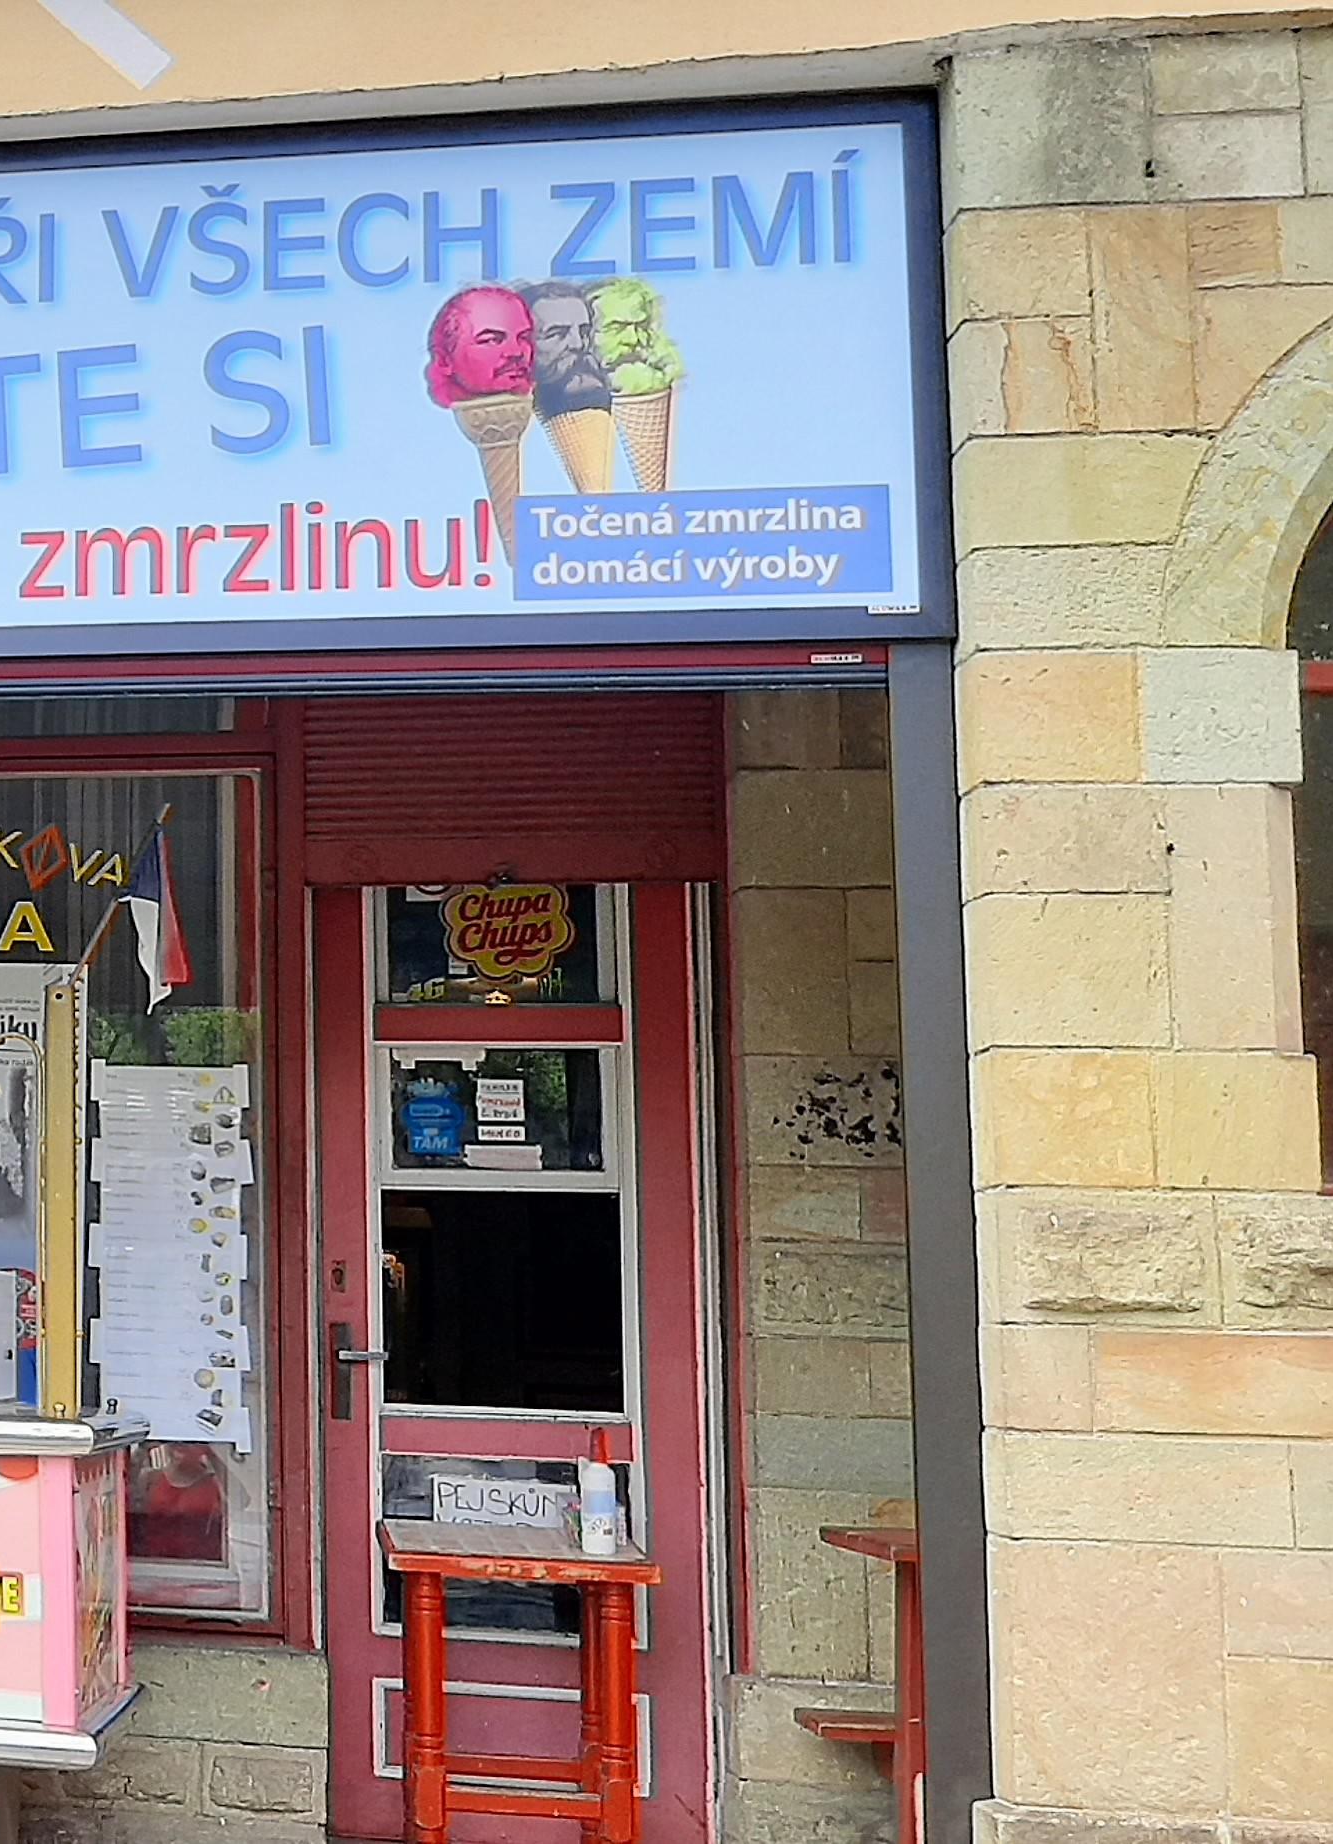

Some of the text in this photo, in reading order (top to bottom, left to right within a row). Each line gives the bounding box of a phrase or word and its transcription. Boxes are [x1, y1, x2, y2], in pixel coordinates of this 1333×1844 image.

[102, 184, 499, 298] VŠECH
[548, 148, 861, 277] ZEMÍ
[203, 325, 332, 455] SI
[530, 498, 862, 538] Točená zmrzlina
[19, 500, 493, 599] zmrzlinu!
[532, 546, 839, 589] domácí výroby
[459, 893, 551, 923] Chupa
[458, 920, 552, 965] Chups
